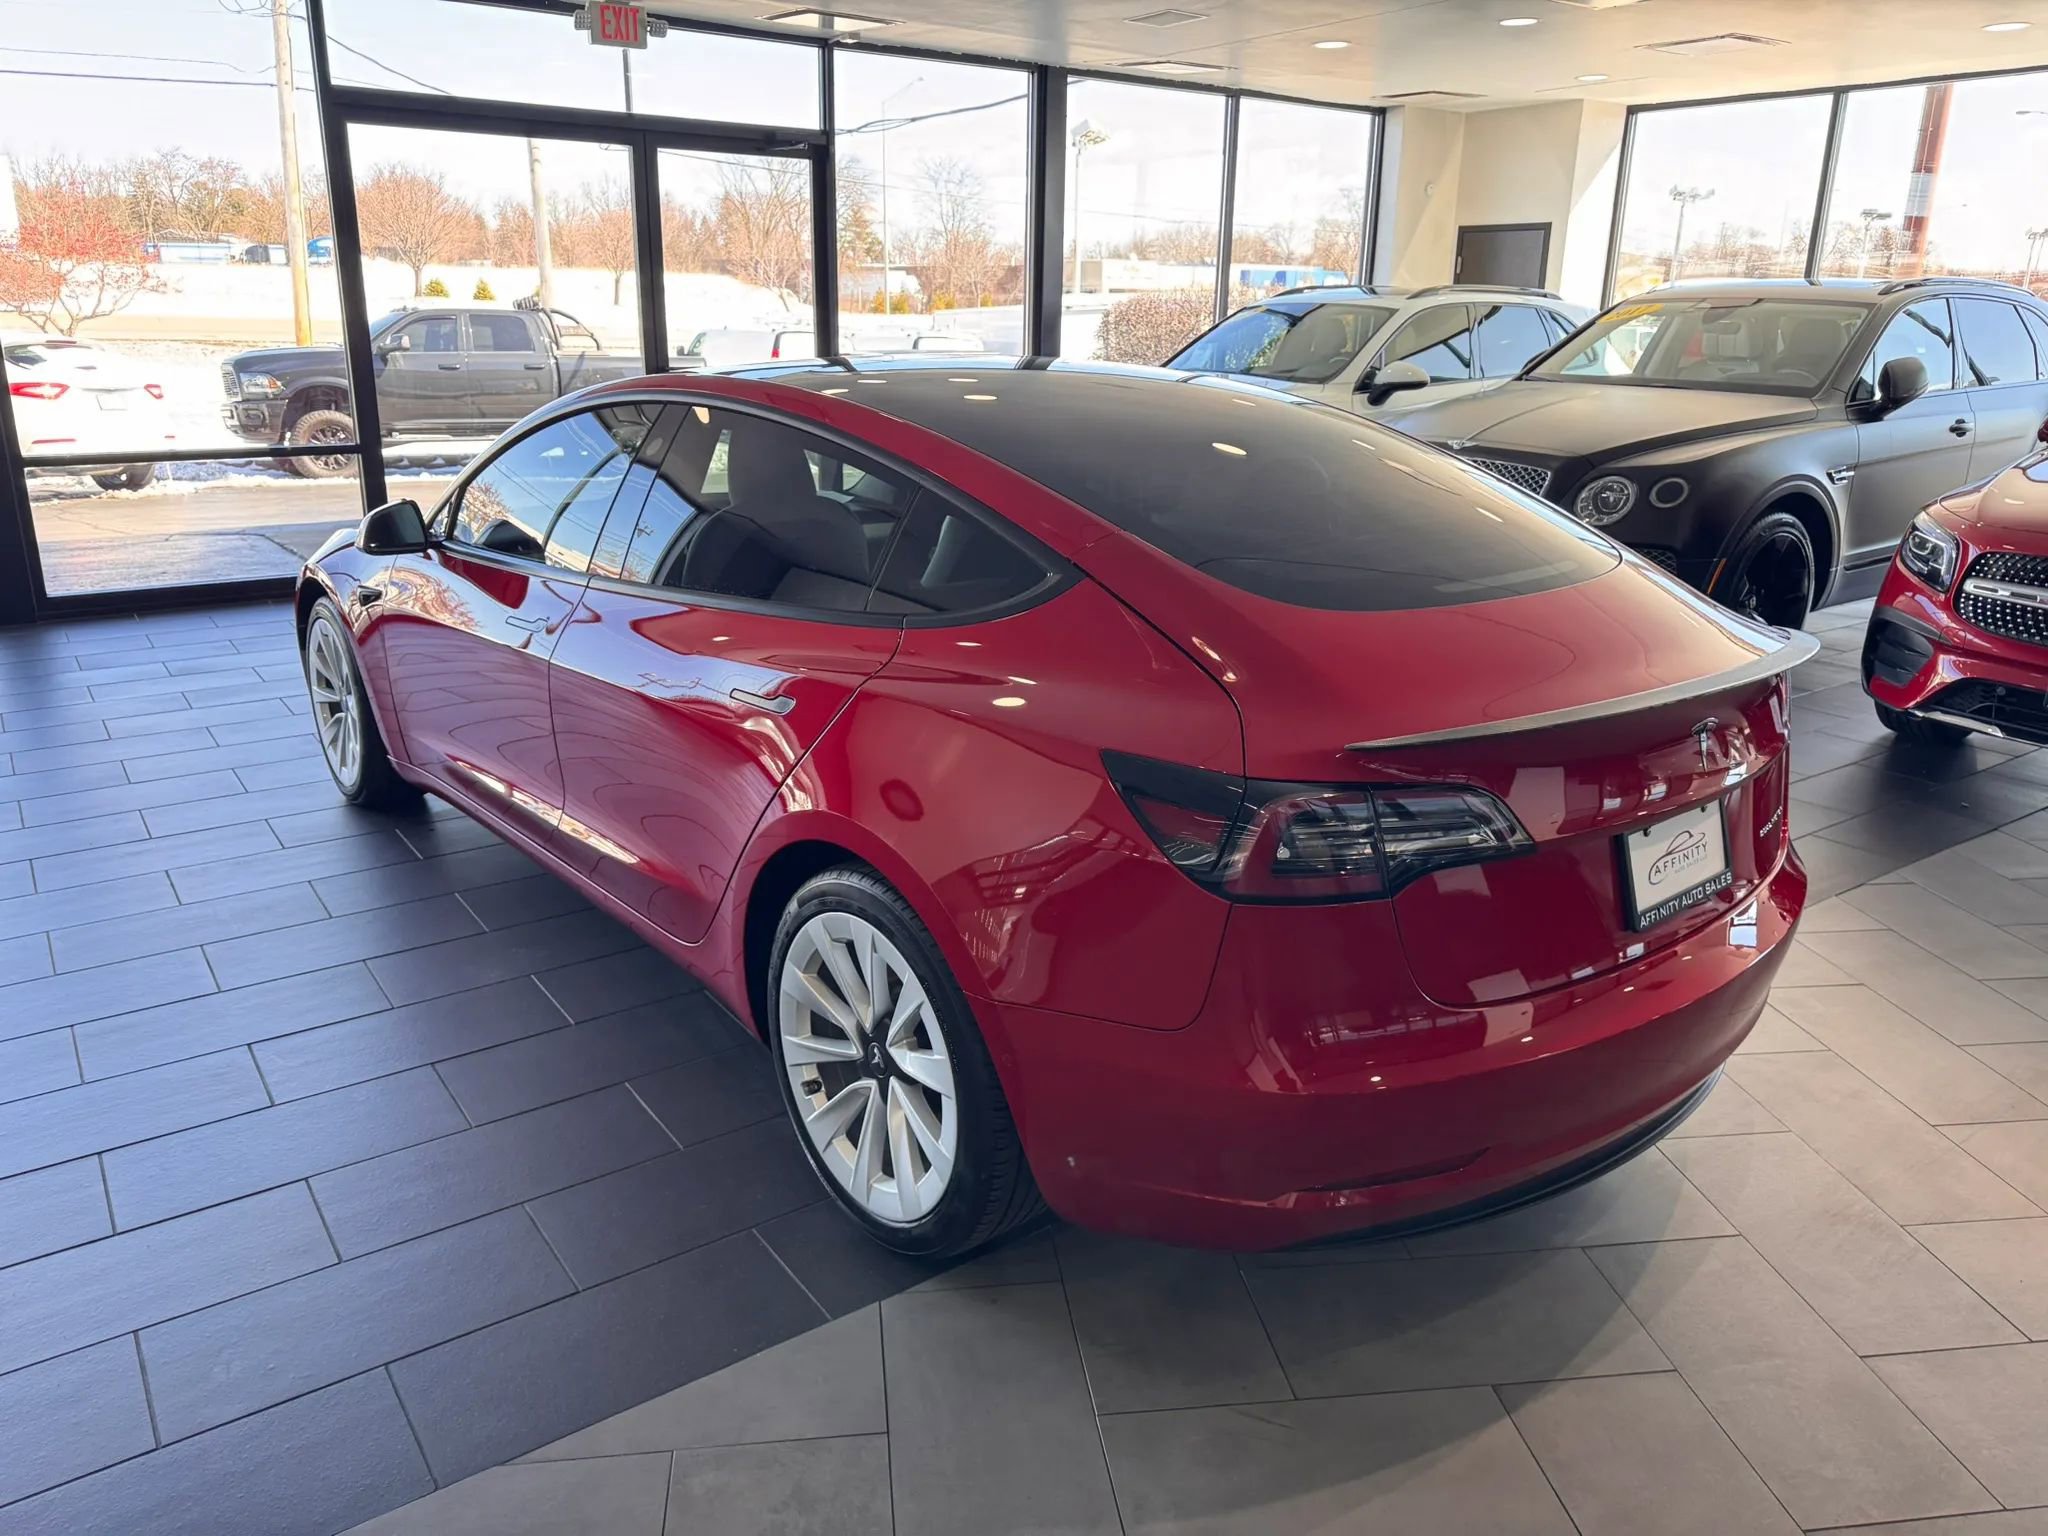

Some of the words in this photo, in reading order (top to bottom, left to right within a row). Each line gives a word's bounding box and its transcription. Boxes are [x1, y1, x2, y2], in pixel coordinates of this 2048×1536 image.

[600, 4, 639, 42] EXIT
[1654, 841, 1708, 876] AFFINITY
[1640, 899, 1680, 928] AFFINITY
[1681, 887, 1703, 910] AUTO
[1705, 872, 1732, 895] SALES
